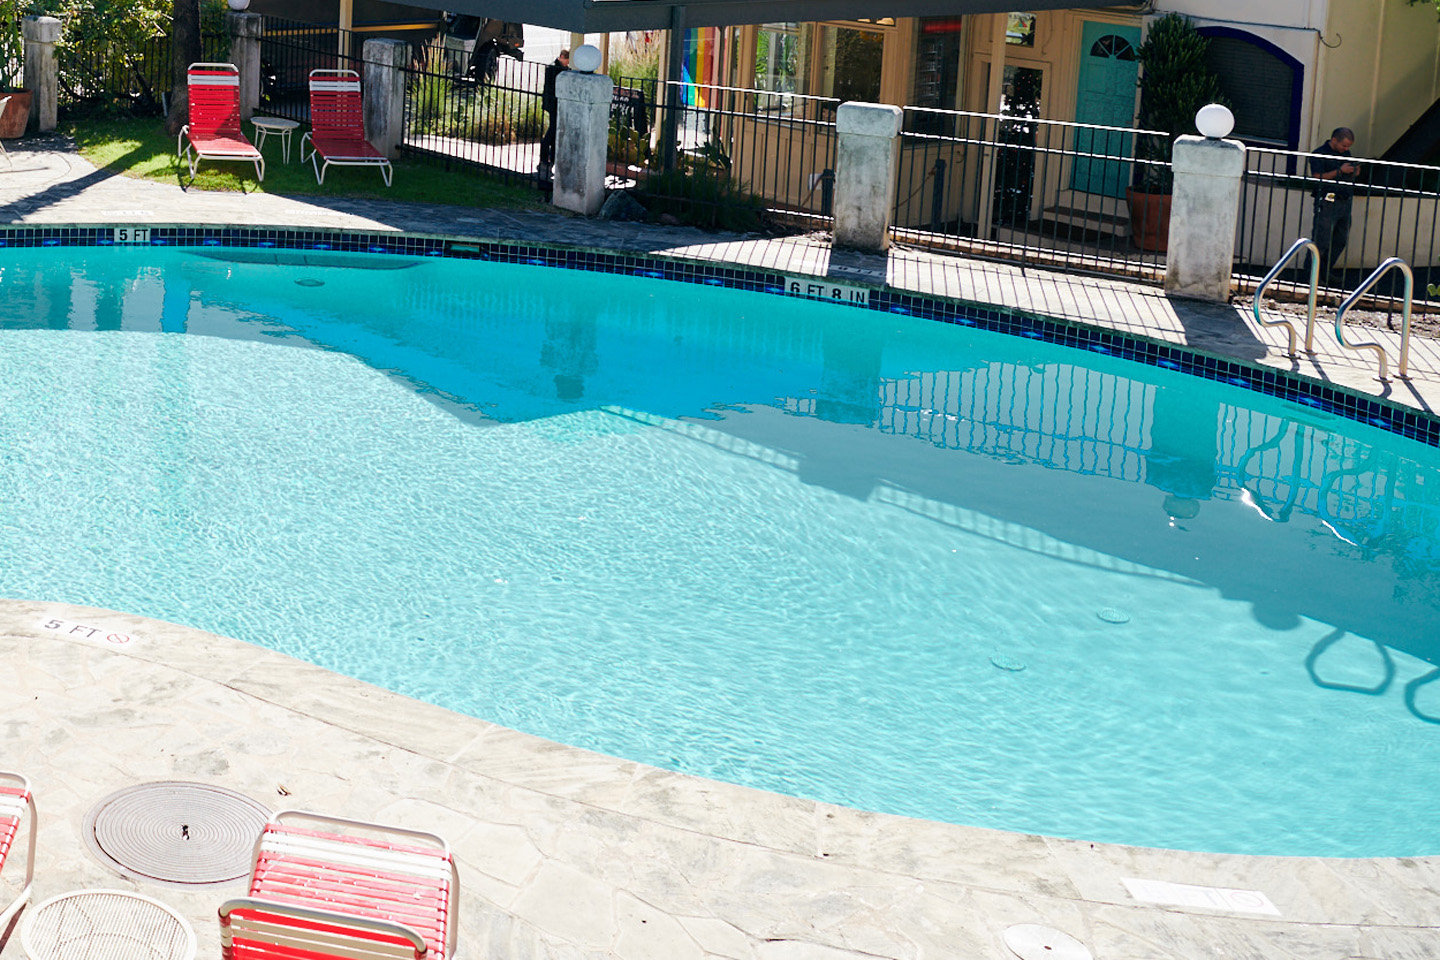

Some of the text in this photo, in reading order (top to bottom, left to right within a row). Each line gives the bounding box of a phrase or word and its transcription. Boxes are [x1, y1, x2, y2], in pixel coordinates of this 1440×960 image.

[119, 229, 149, 241] 5 FT
[790, 281, 865, 303] 6 FT 8 IN
[44, 620, 102, 638] 5 FT
